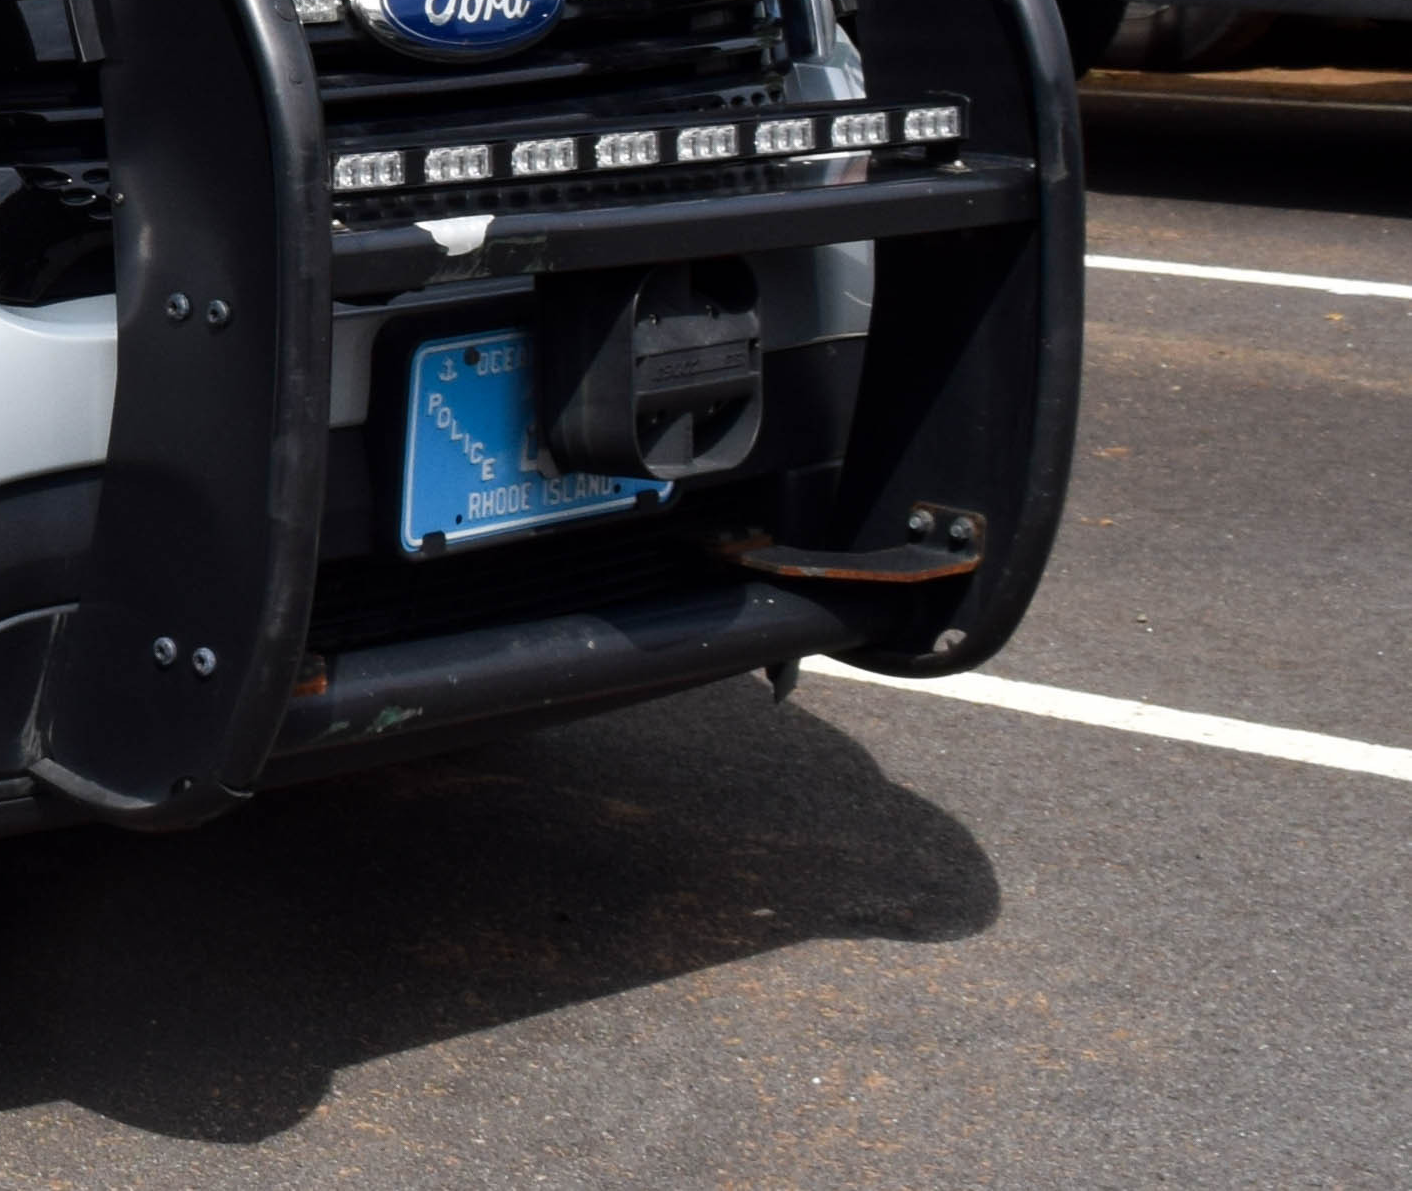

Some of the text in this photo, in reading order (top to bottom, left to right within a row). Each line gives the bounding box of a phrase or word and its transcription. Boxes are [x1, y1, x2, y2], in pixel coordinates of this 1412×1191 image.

[476, 346, 528, 377] OCE
[427, 392, 497, 482] POLICE
[468, 475, 614, 520] RHODE ISLAND
